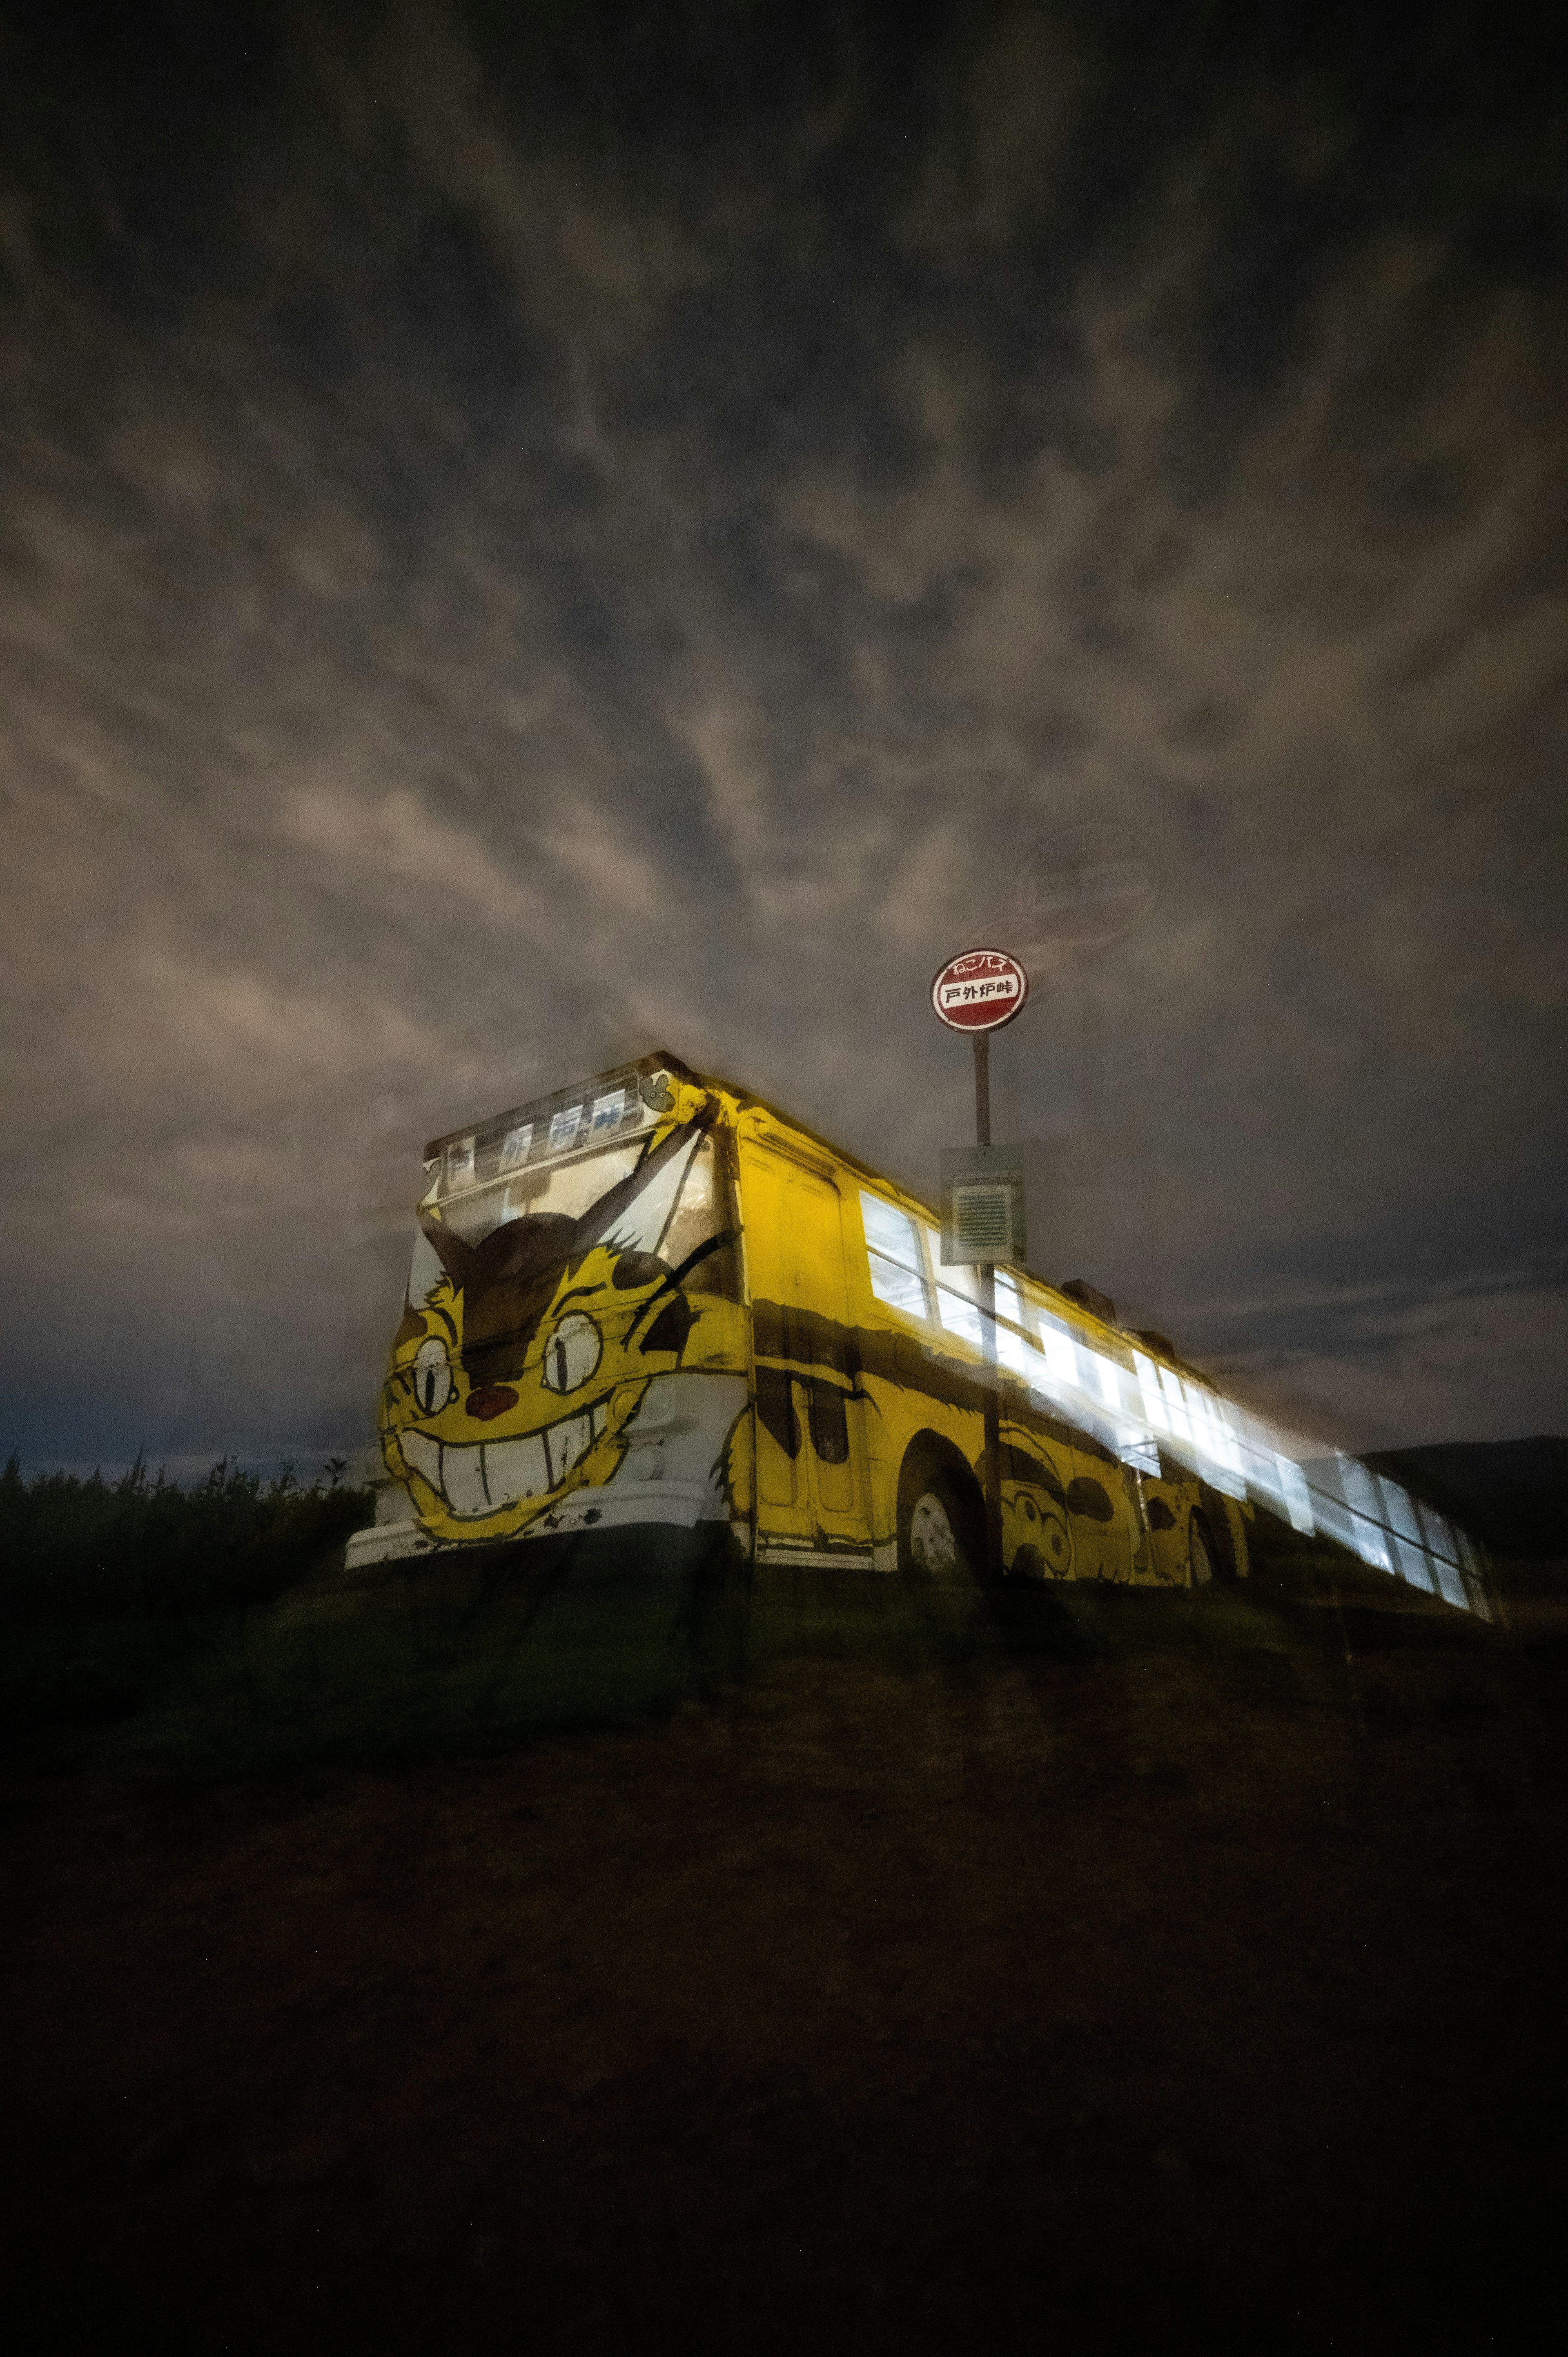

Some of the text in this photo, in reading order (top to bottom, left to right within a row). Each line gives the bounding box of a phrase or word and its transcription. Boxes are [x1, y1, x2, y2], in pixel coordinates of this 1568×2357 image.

[952, 956, 1007, 975] ねこバス
[946, 981, 1013, 1003] 戸外炉峠
